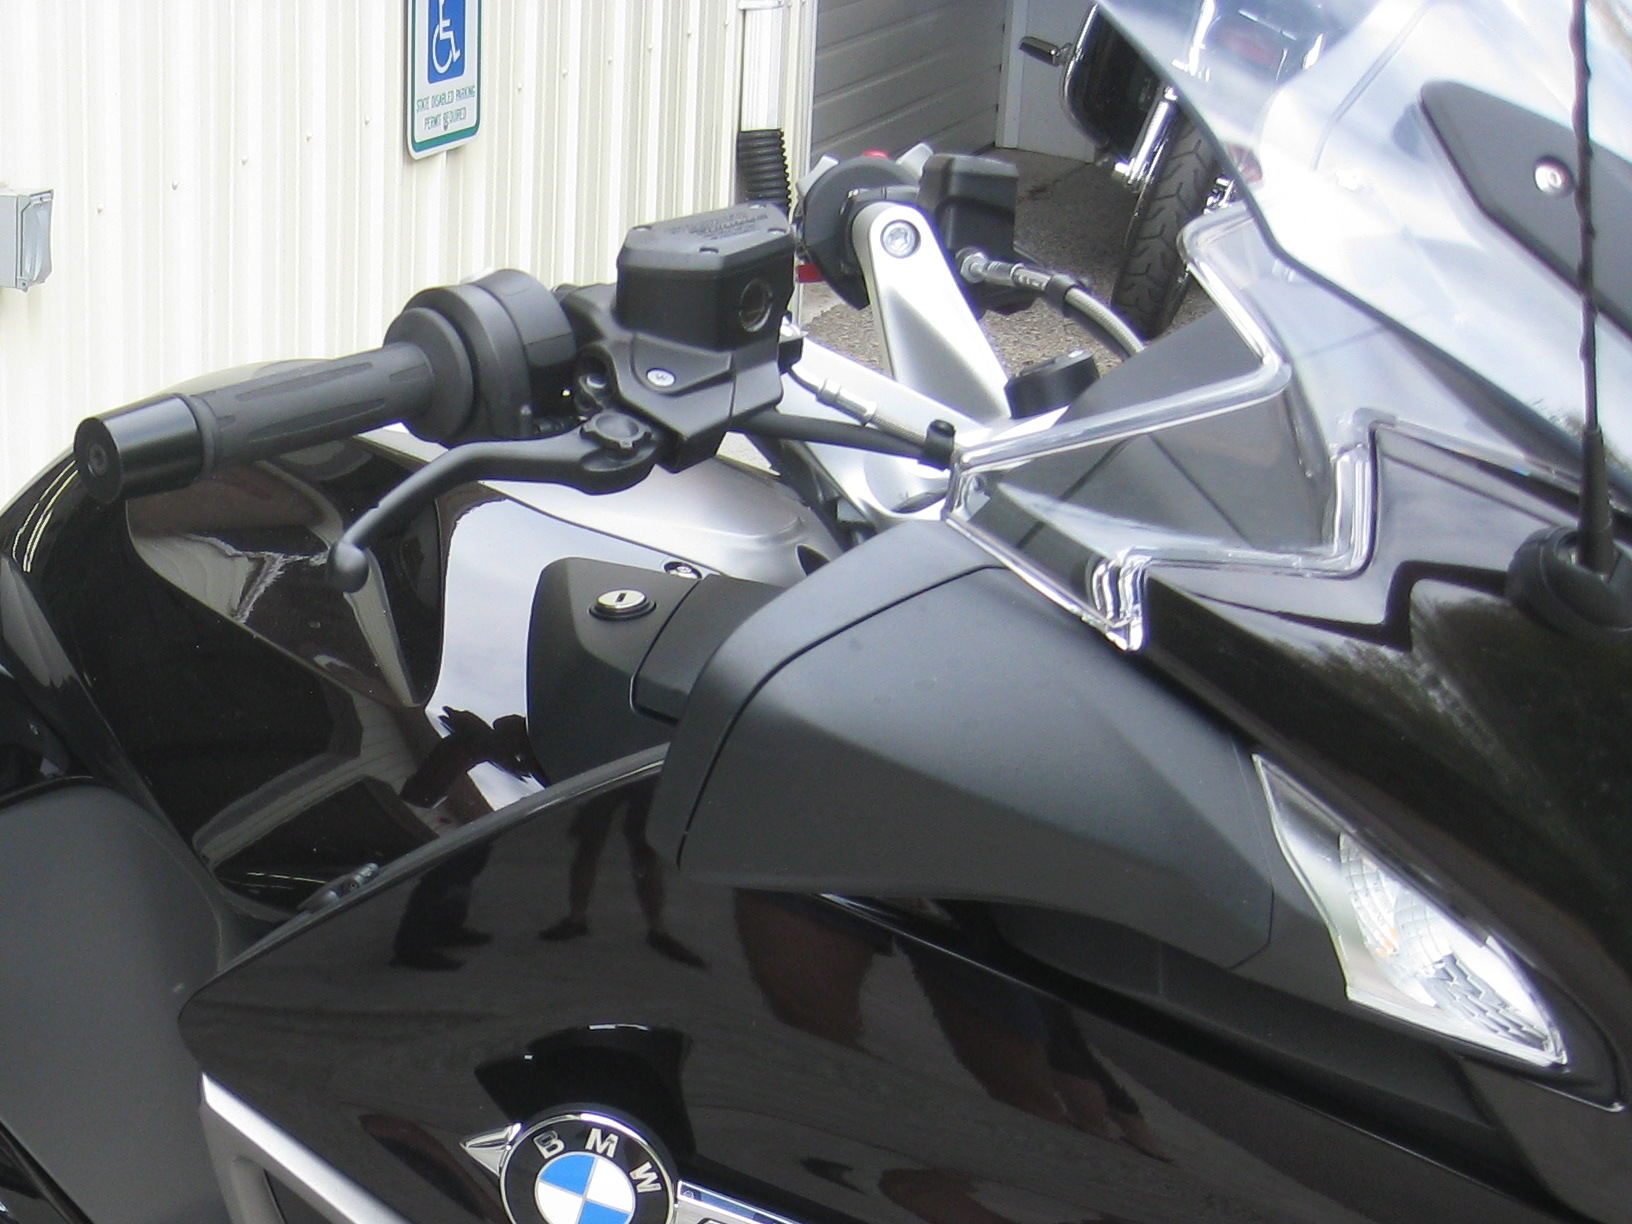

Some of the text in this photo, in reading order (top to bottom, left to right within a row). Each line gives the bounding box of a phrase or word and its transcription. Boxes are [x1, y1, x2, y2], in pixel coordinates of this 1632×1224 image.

[416, 85, 475, 113] STATE DISABLED PARKING
[424, 106, 467, 130] PERMIT REQUIRED
[533, 1127, 663, 1193] BMW
